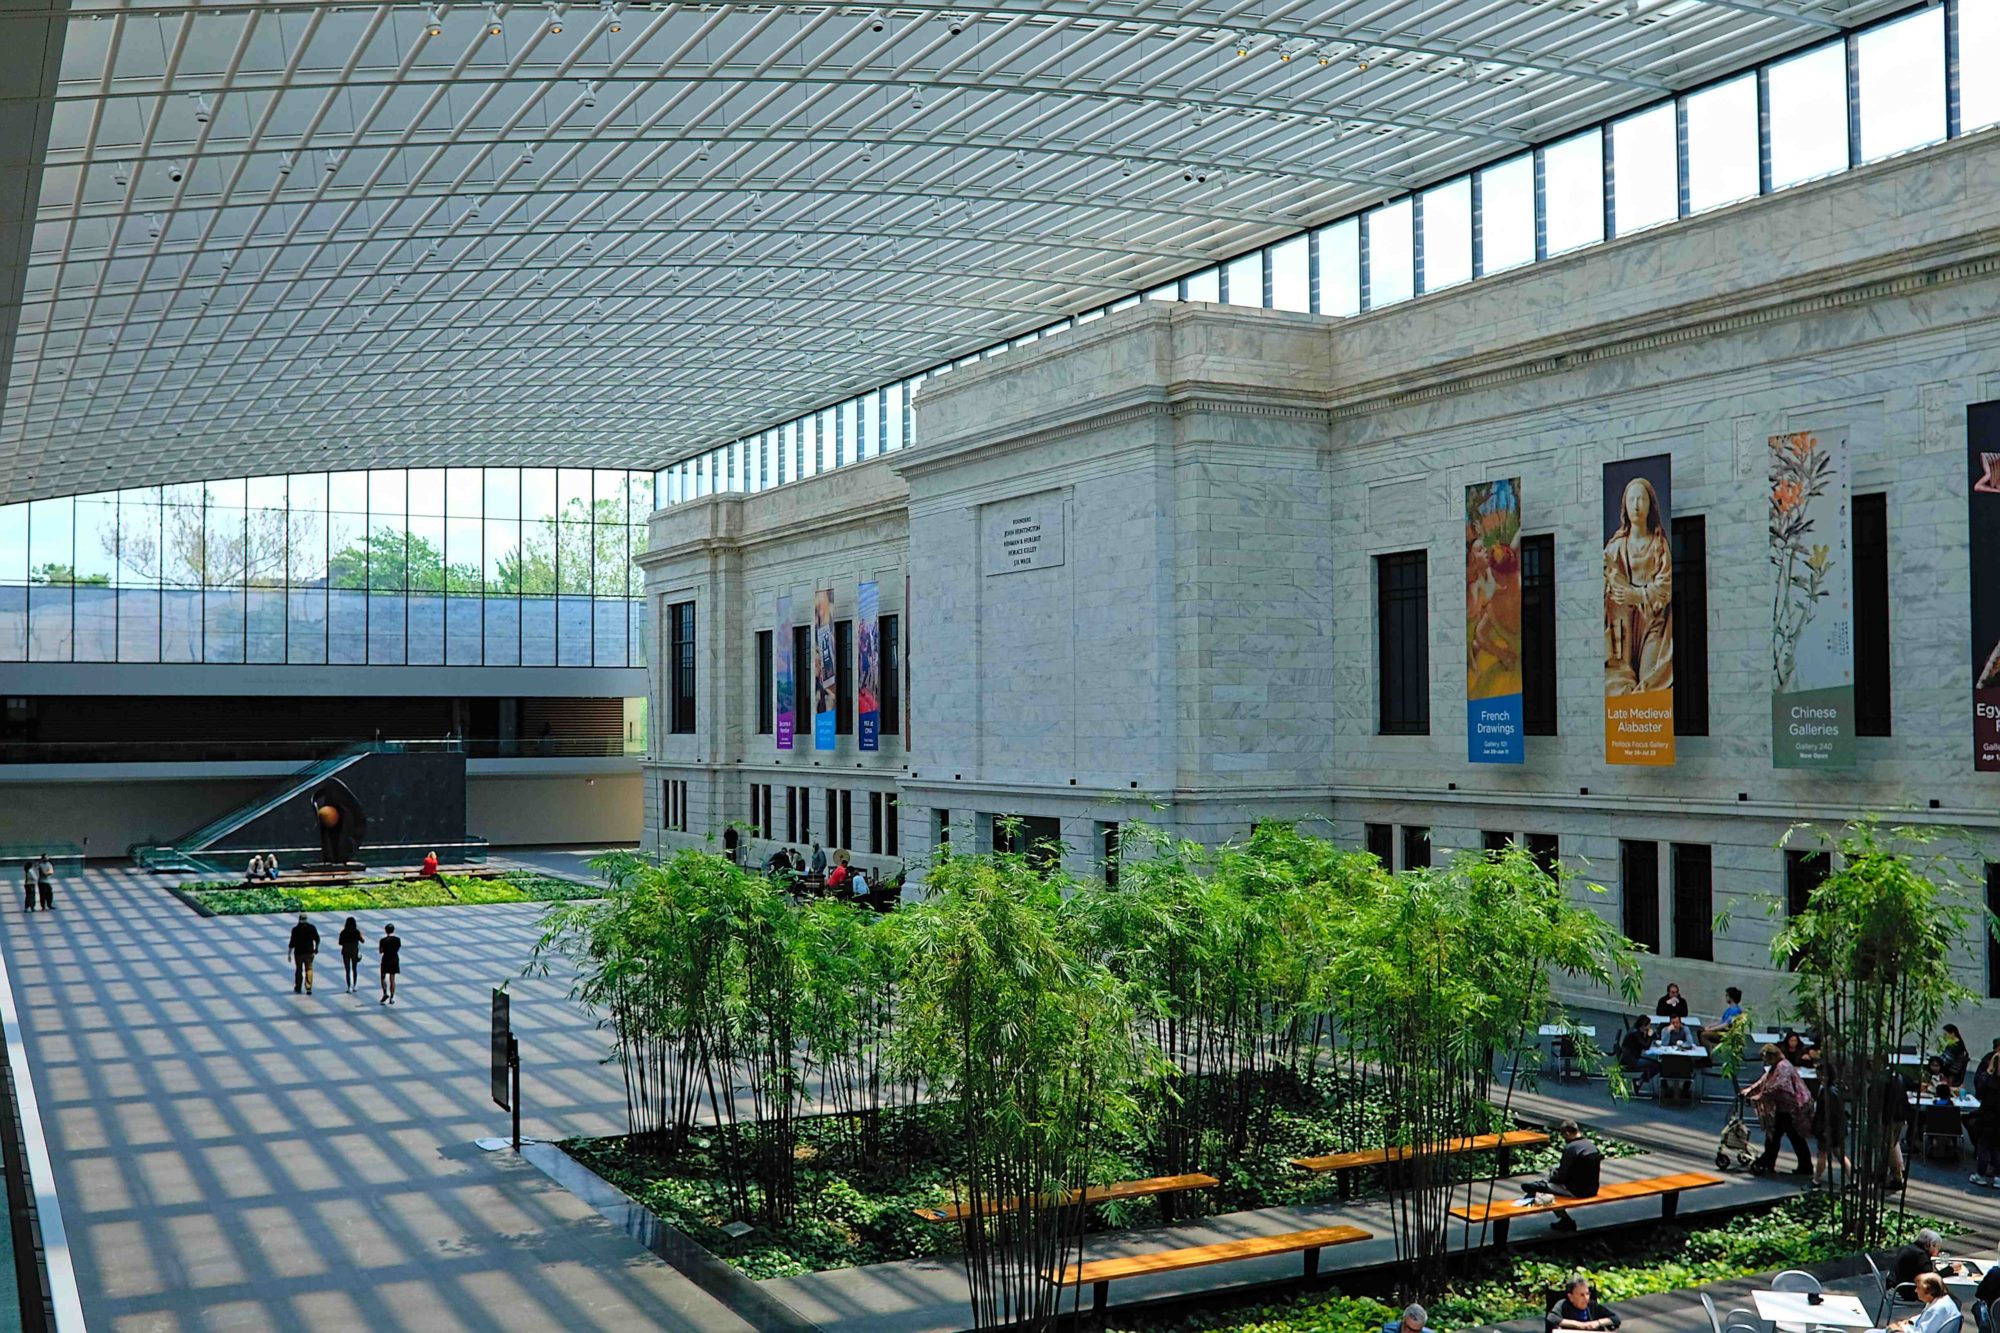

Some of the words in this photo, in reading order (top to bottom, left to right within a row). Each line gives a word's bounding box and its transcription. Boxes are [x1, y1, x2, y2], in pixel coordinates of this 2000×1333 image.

[1481, 710, 1510, 721] French
[1607, 708, 1628, 719] Late
[1630, 707, 1671, 719] Medieval
[1791, 706, 1837, 719] Chinese
[1477, 723, 1515, 735] Drawings
[1618, 721, 1662, 732] Alabaster
[1789, 723, 1839, 736] Galleries
[1649, 740, 1669, 749] Gallery
[1795, 742, 1817, 751] Gallery
